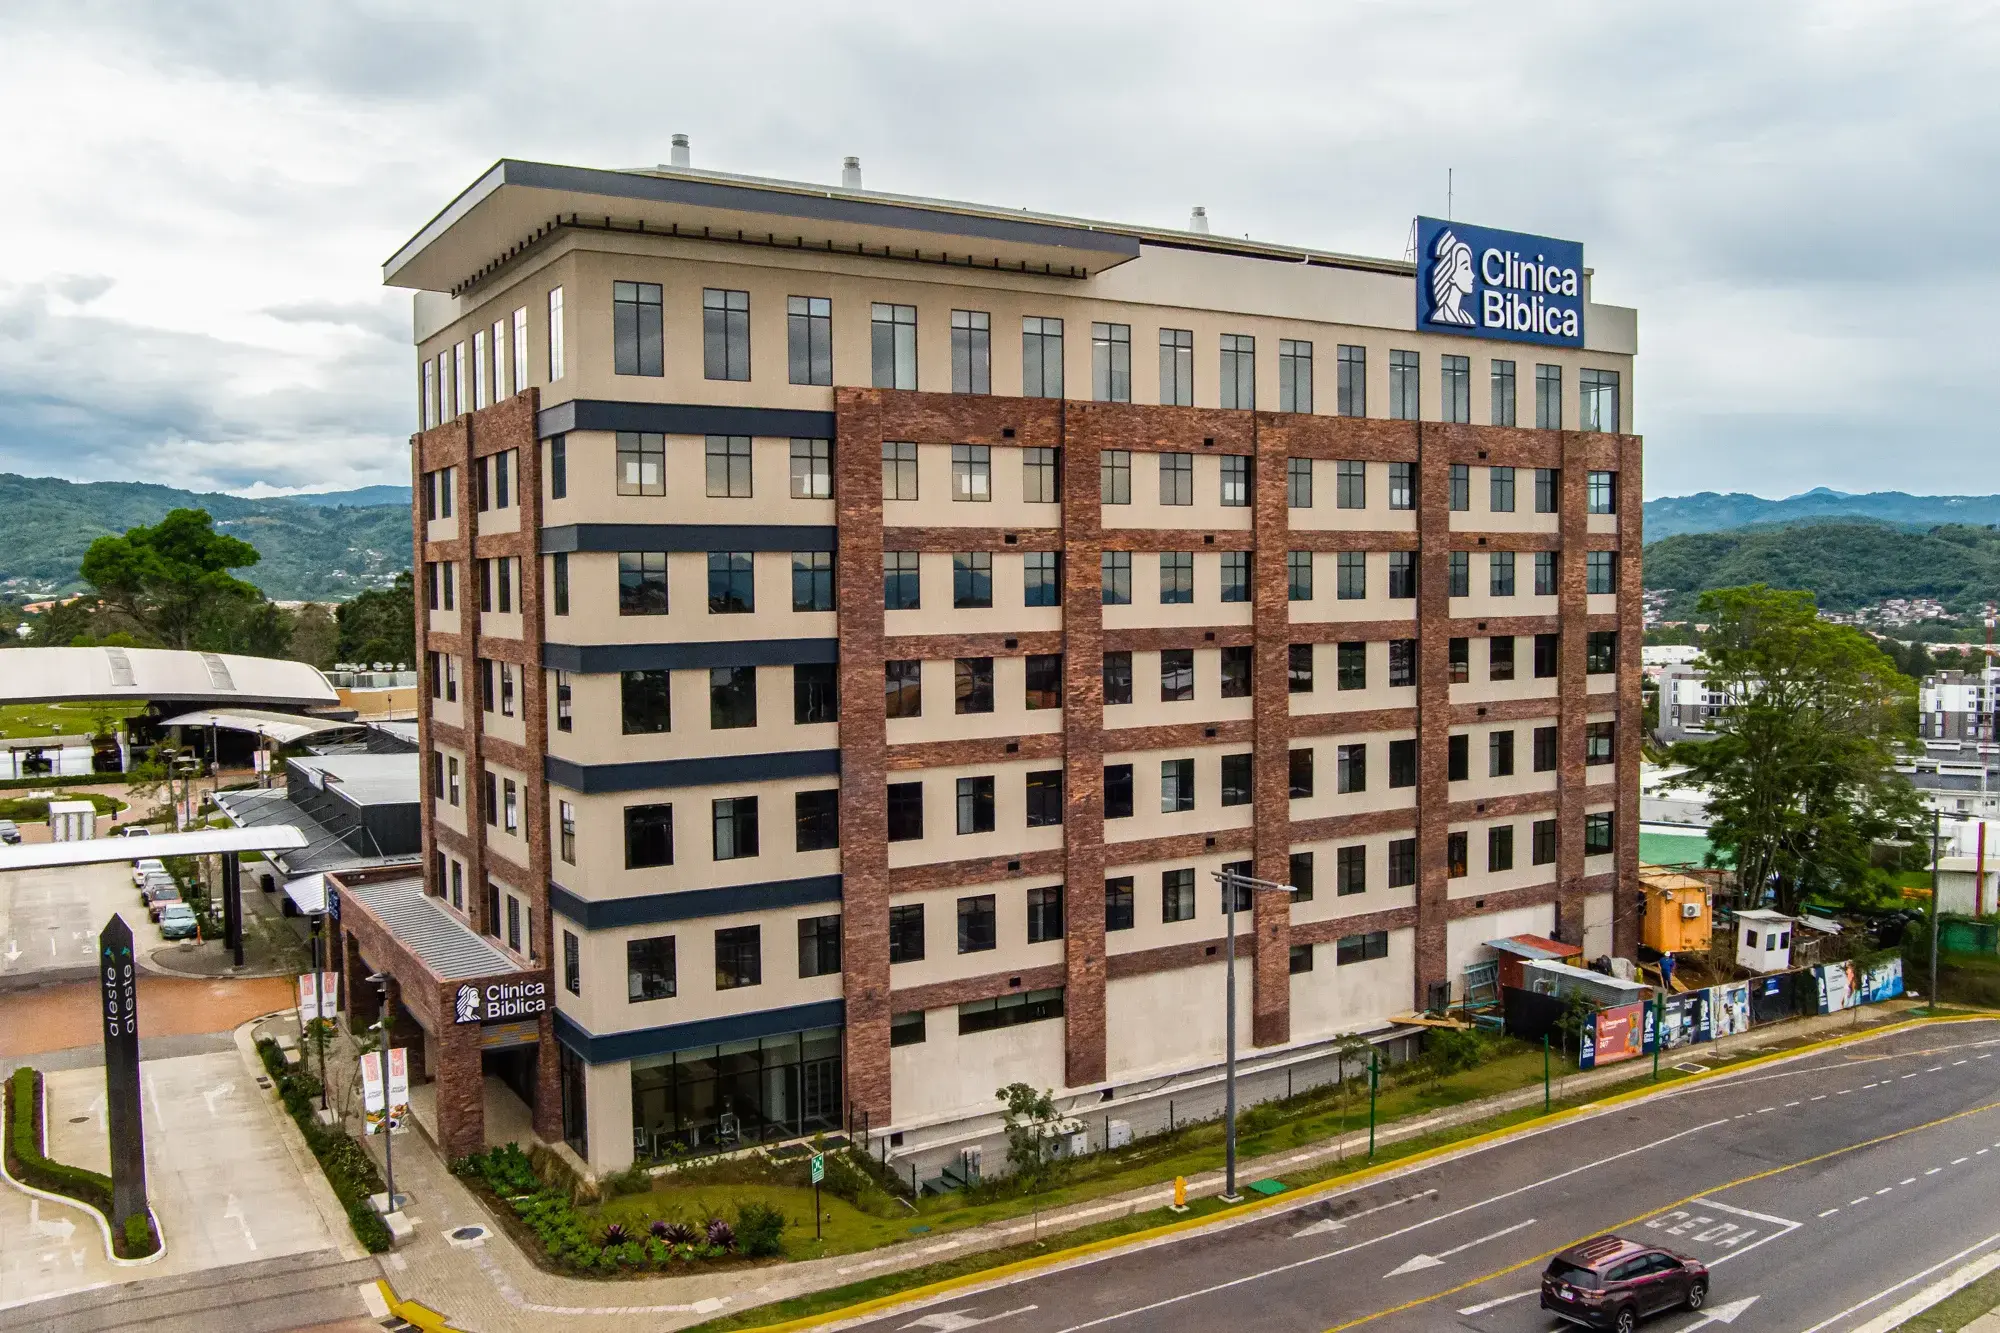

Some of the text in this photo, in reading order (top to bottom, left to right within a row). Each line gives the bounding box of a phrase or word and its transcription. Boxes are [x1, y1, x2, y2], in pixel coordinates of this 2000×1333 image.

[1481, 248, 1578, 297] Clínica
[1483, 289, 1579, 337] Bíblica
[106, 967, 119, 1036] aleste
[123, 964, 135, 1033] aleste
[486, 980, 545, 1001] Clínica
[487, 998, 546, 1018] Bíblica
[1644, 1211, 1758, 1248] CEDA
